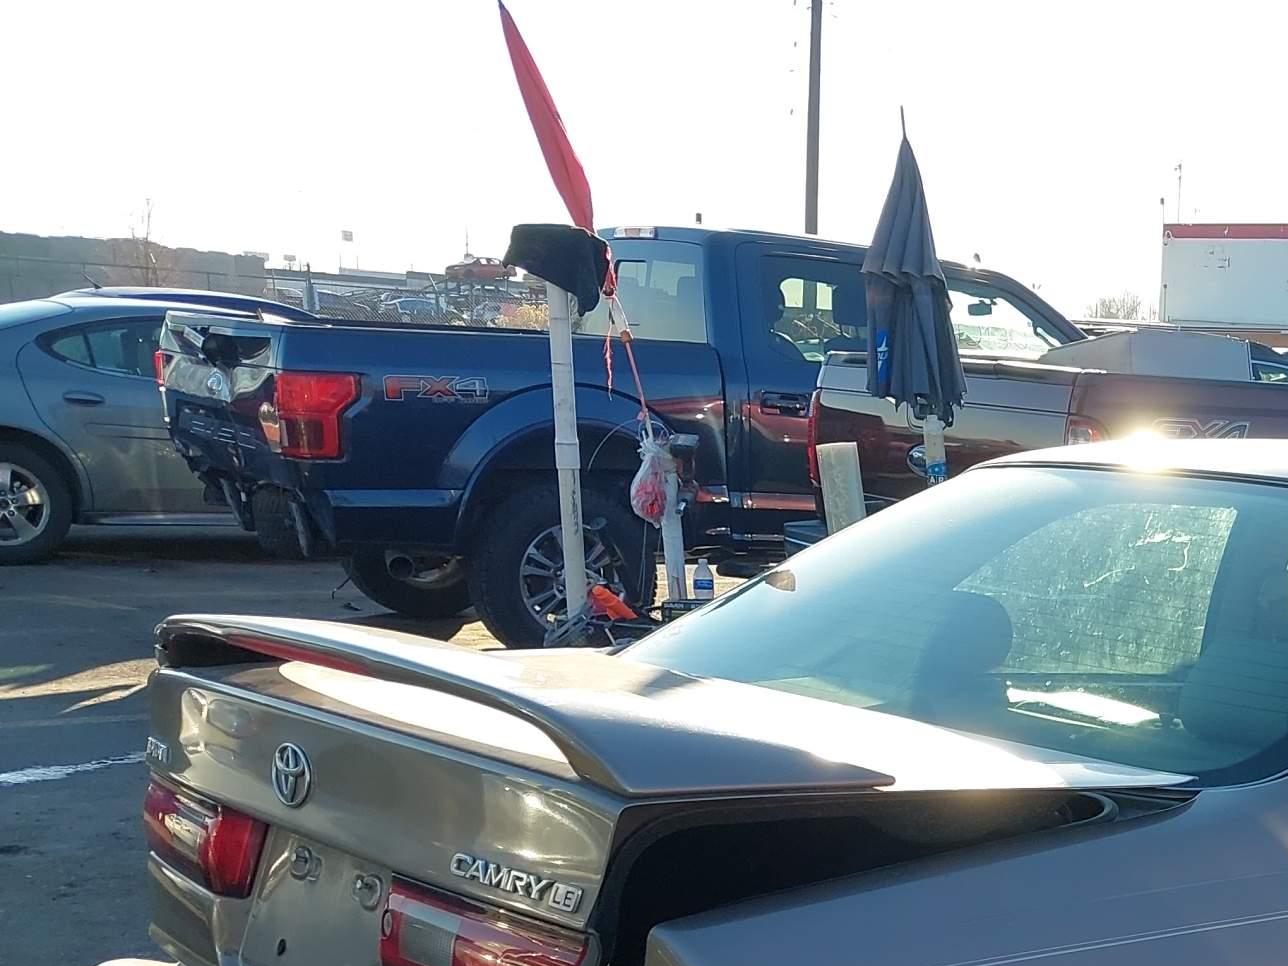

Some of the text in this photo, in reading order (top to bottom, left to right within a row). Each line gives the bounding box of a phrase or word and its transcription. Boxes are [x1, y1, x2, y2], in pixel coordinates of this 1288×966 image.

[383, 374, 489, 401] FX4
[450, 852, 582, 913] CAMRY LE
